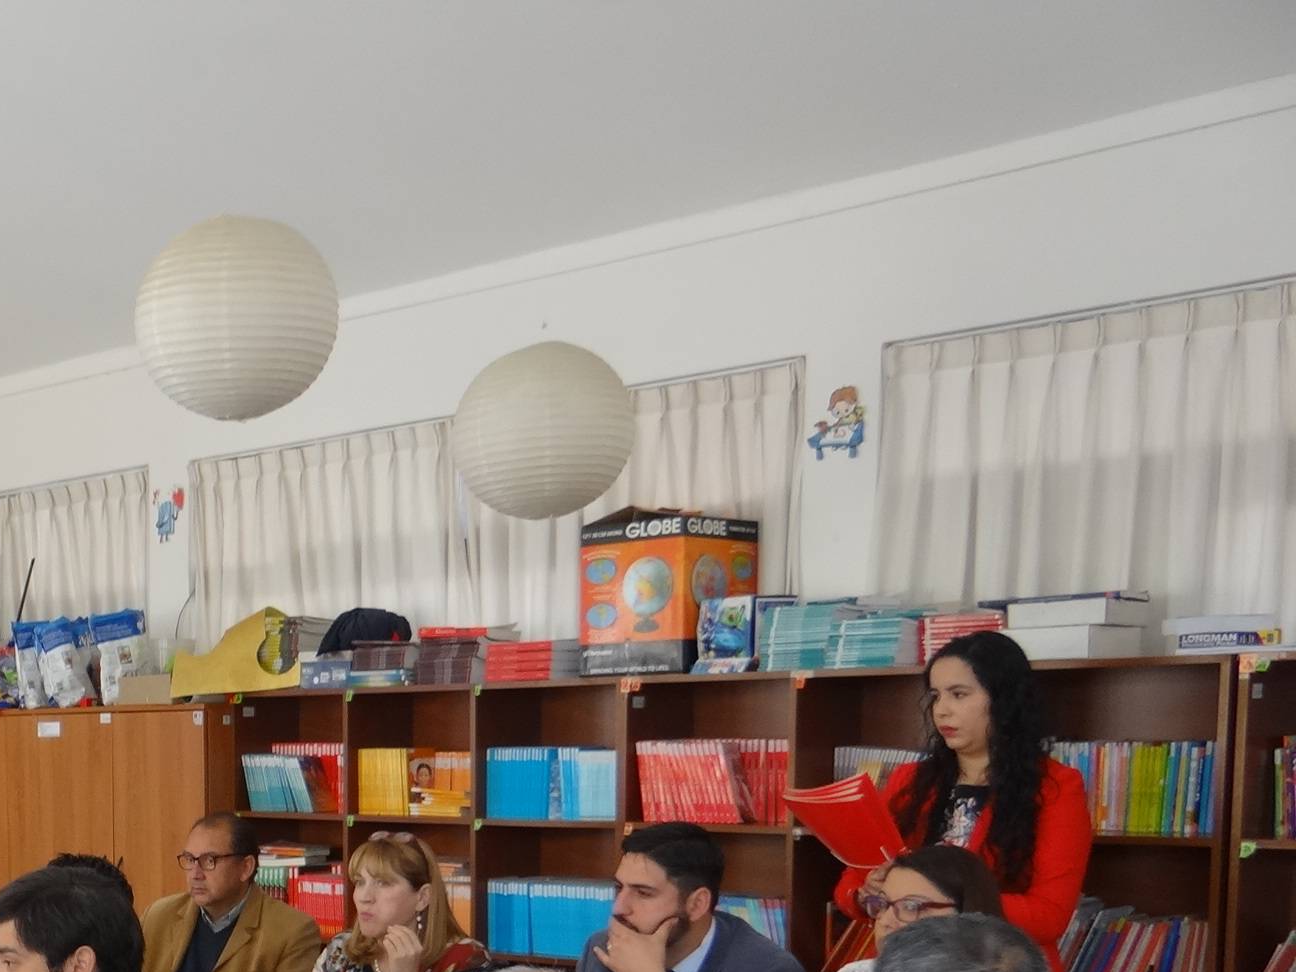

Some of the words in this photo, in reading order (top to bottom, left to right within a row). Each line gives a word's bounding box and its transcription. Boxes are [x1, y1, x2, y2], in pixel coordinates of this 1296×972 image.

[625, 517, 682, 539] GLOBE
[686, 518, 728, 537] GLOBE
[1182, 633, 1237, 644] LONGMAN
